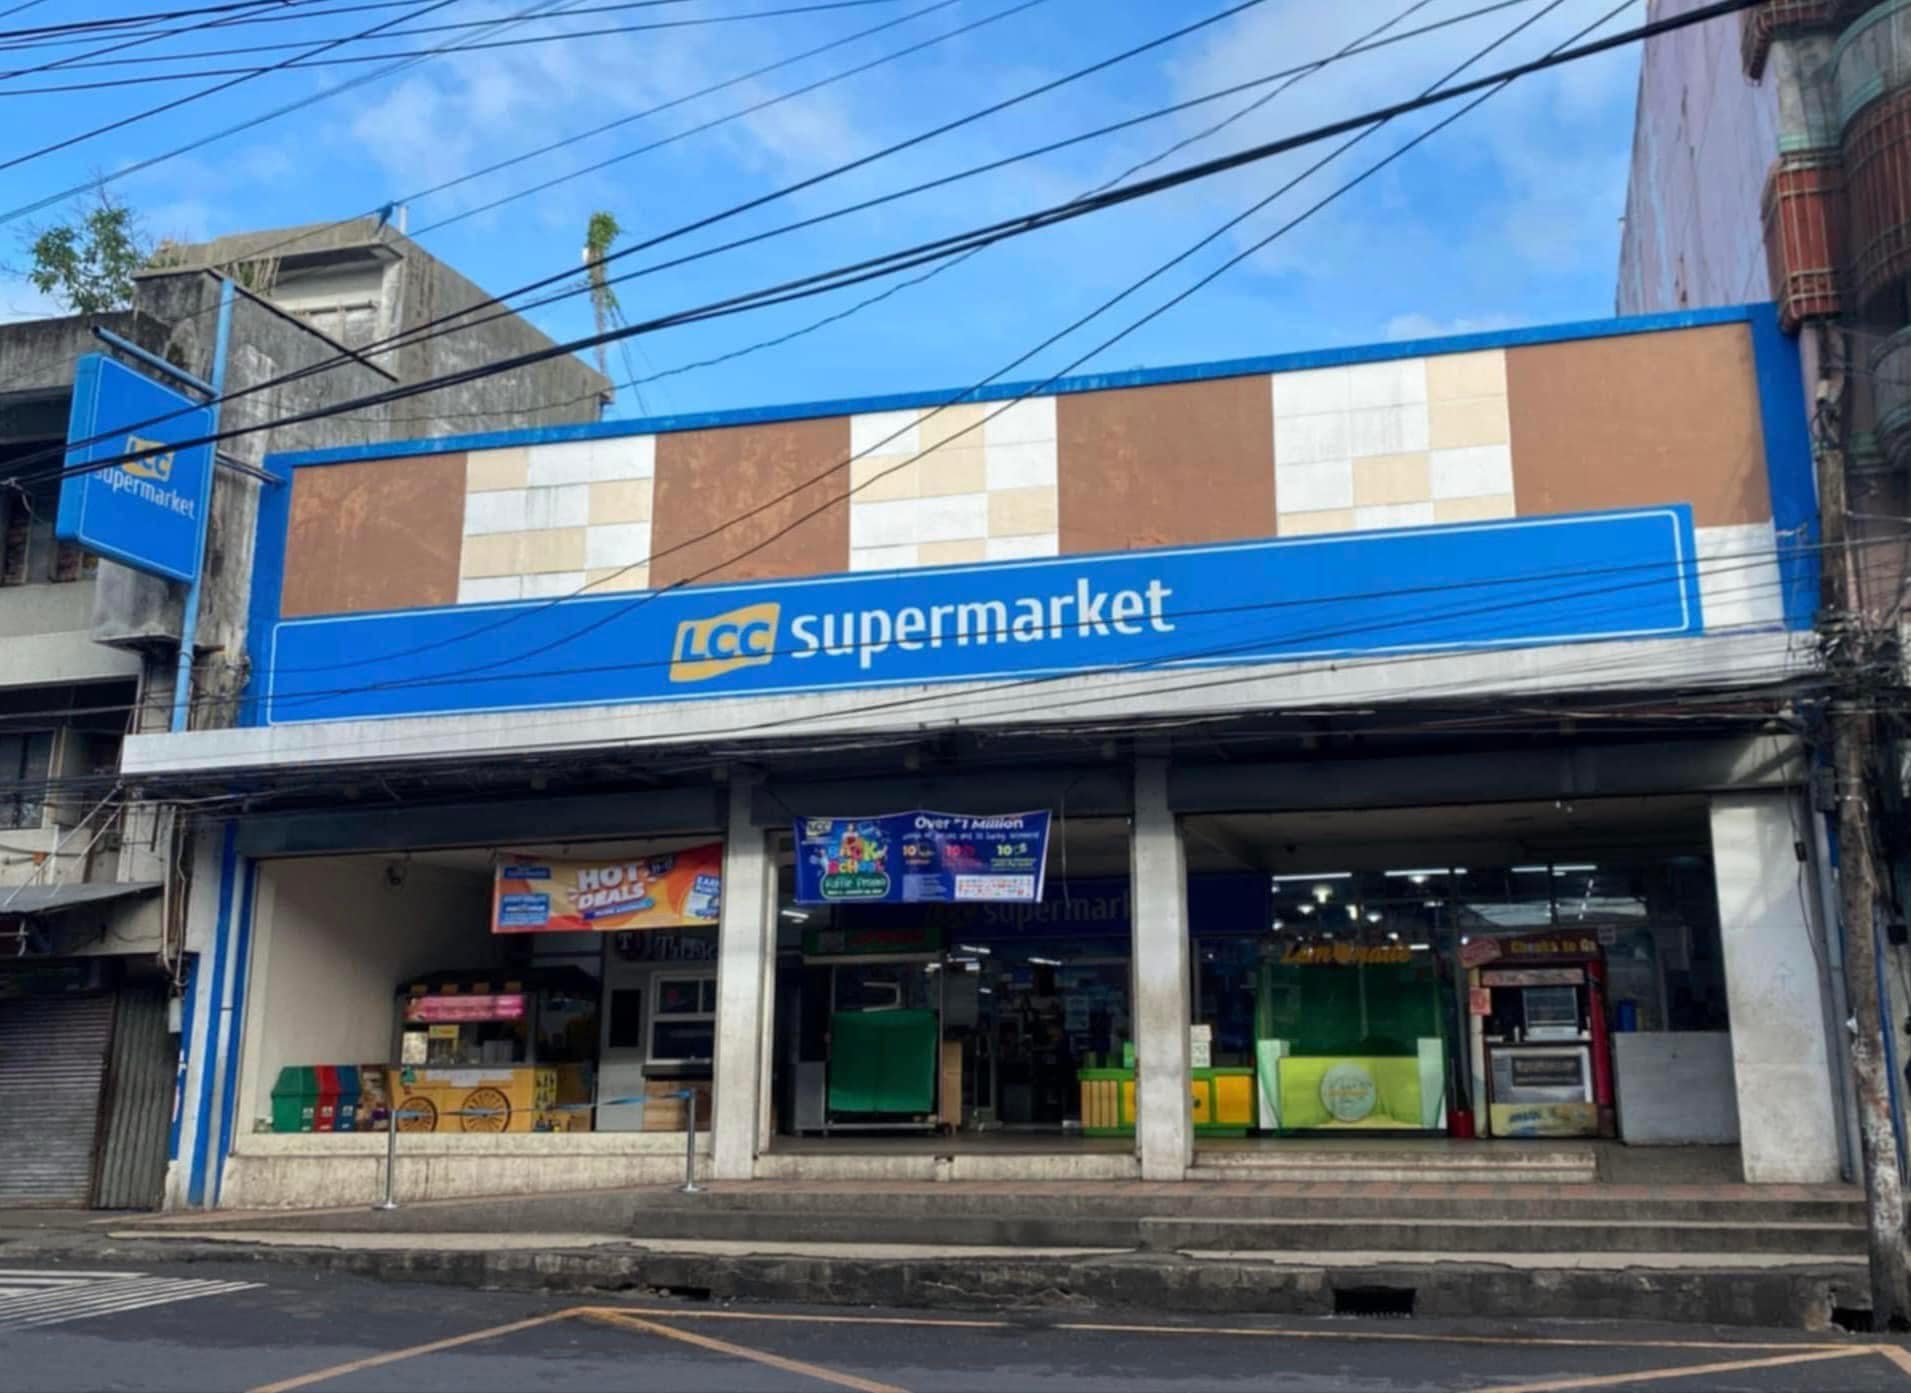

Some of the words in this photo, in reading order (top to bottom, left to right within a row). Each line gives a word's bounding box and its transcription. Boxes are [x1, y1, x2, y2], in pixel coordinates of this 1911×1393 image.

[93, 464, 195, 520] supermarket
[681, 619, 773, 660] LCC
[790, 577, 1176, 670] supermarket
[914, 816, 950, 830] Over
[971, 816, 1024, 830] Million
[578, 862, 645, 894] HOT
[577, 882, 645, 910] DEALS
